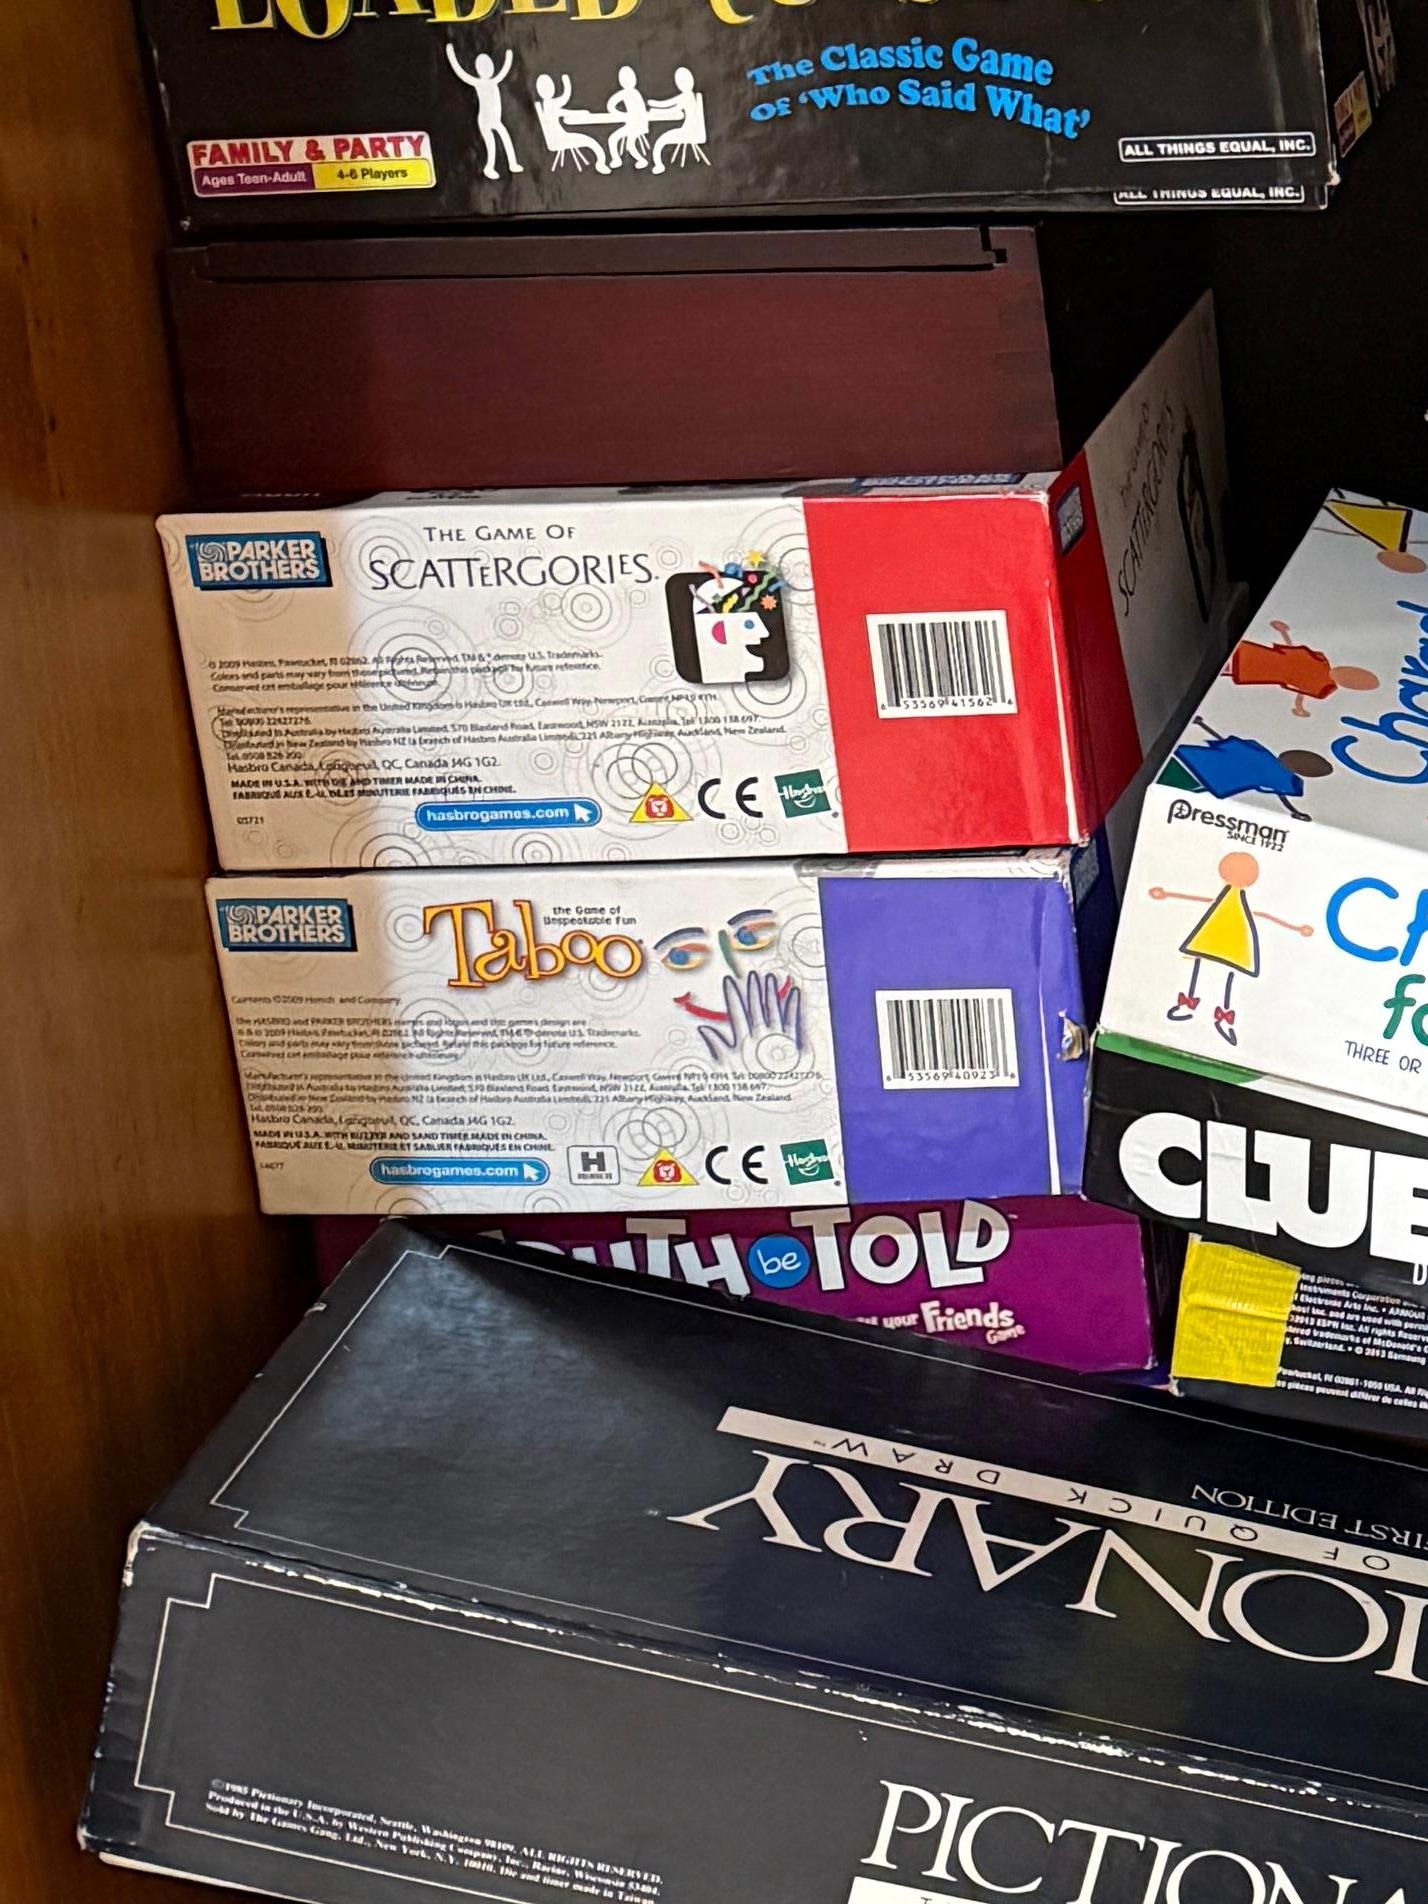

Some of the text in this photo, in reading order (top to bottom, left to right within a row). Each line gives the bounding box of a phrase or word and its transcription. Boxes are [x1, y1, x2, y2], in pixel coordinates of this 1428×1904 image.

[747, 35, 1054, 88] The Classic Game
[191, 134, 425, 166] FAMILY & PARTY
[1124, 138, 1311, 157] ALL THINGS EQUAL, INC.
[202, 170, 307, 188] Ages Teen-Adult
[423, 524, 575, 542] THE GAME OF
[226, 540, 314, 561] PARKER
[198, 559, 320, 581] BROTHERS
[370, 552, 654, 591] SCATTERGORIES
[426, 804, 570, 823] hasbrogames.com
[256, 904, 343, 925] PARKER
[228, 923, 345, 944] BROTHERS
[423, 900, 645, 989] Taboo
[1344, 1040, 1391, 1066] THREE
[1398, 1055, 1422, 1073] OR
[380, 1163, 519, 1181] hasbrogames.com
[791, 1200, 1010, 1291] TOLD
[759, 1246, 802, 1275] be
[883, 1300, 1015, 1335] your Friends
[1190, 1484, 1340, 1533] EDITION
